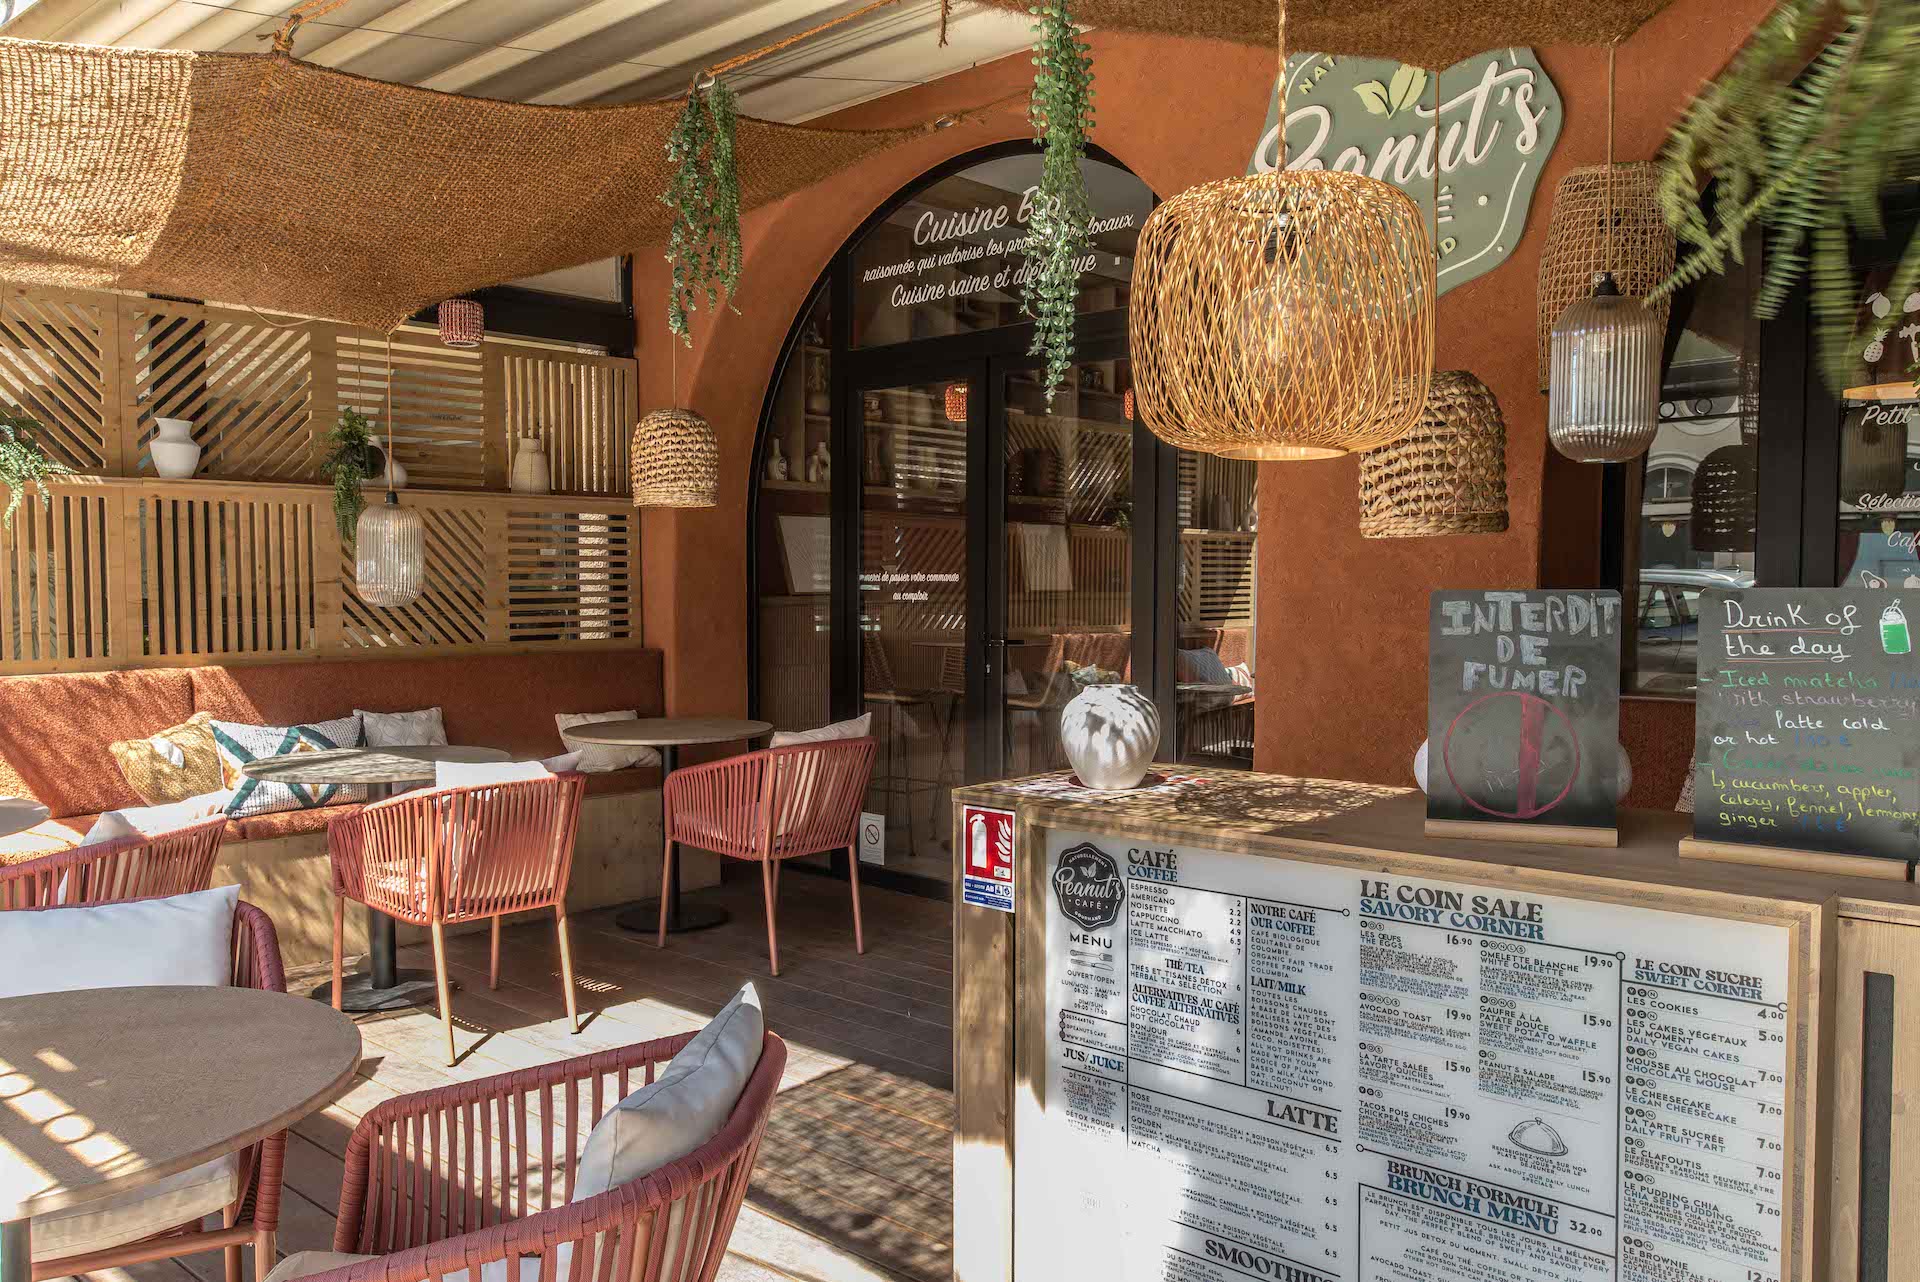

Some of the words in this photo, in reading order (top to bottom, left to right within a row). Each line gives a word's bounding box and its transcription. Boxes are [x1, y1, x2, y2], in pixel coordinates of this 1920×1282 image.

[914, 204, 1010, 246] Cuisine
[1016, 186, 1061, 222] Bo
[863, 260, 915, 282] raisonnée
[917, 254, 936, 276] qui
[938, 244, 984, 267] valorise
[986, 238, 1004, 256] les
[891, 284, 945, 308] Cuisine
[948, 273, 990, 297] saine
[994, 264, 1010, 289] et
[882, 571, 889, 582] de
[911, 571, 926, 582] votre
[927, 573, 959, 582] commande
[893, 592, 901, 600] au
[902, 590, 928, 603] comptoir
[1724, 599, 1810, 628] Drink
[1825, 605, 1862, 635] of
[1497, 634, 1548, 665] DE
[1726, 634, 1775, 657] the
[1790, 636, 1851, 663] day
[1463, 661, 1587, 698] FUMER
[1719, 670, 1771, 688] Iced
[1784, 672, 1880, 689] matcha
[1843, 717, 1890, 730] cold
[1714, 735, 1737, 745] or
[1746, 731, 1779, 745] hot
[1720, 812, 1778, 828] ginger
[1128, 848, 1177, 870] CAFÉ
[1056, 866, 1122, 900] Peanut's
[1128, 865, 1177, 882] COFFEE
[1131, 883, 1168, 894] ESPRESSO
[1075, 899, 1101, 909] CAFÉ
[1131, 893, 1175, 905] AMERICANO
[1131, 902, 1168, 913] NOISETTE
[1361, 880, 1389, 900] LE
[1397, 885, 1463, 911] COIN
[1472, 896, 1543, 923] SALE
[1131, 911, 1179, 925] CAPPUCCINO
[1229, 918, 1241, 926] 2.2
[1250, 903, 1286, 918] NOTRE
[1289, 909, 1316, 923] CAFÉ
[1361, 899, 1444, 924] SAVORY
[1450, 911, 1544, 940] CORNER
[1131, 920, 1154, 929] LATTE
[1157, 925, 1203, 938] MACCHIATO
[1250, 916, 1272, 929] OUR
[1276, 920, 1315, 936] COFFEE
[1361, 930, 1375, 938] LES
[1070, 932, 1112, 948] MENU
[1145, 931, 1168, 941] LATTE
[1273, 934, 1320, 946] BIOLOGIQUE
[1380, 940, 1402, 949] EGGS
[1447, 934, 1472, 946] 16.90
[1165, 958, 1204, 975] THÉ/TEA
[1480, 950, 1530, 964] OMELETTE
[1534, 959, 1579, 972] BLANCHE
[1584, 955, 1612, 968] 19.90
[1131, 963, 1149, 972] THÉS
[1165, 970, 1197, 982] TISANES
[1201, 977, 1227, 989] DÉTOX
[1131, 971, 1157, 982] HERBAL
[1161, 977, 1175, 985] TEA
[1179, 981, 1222, 995] SELECTION
[1636, 958, 1654, 971] LE
[1659, 962, 1701, 978] COIN
[1706, 970, 1763, 989] SUCRE
[1250, 976, 1306, 996] LAIT/MILK
[1635, 970, 1689, 988] SWEET
[1694, 979, 1763, 1000] CORNER
[1132, 983, 1198, 1005] ALTERNATIVES
[1201, 998, 1213, 1008] AU
[1216, 1001, 1239, 1015] CAFÉ
[1627, 997, 1646, 1005] LES
[1650, 1001, 1699, 1016] COOKIES
[1131, 1005, 1171, 1018] CHOCOLAT
[1174, 1015, 1200, 1026] CHAUD
[1132, 993, 1165, 1008] COFFEE
[1168, 1000, 1239, 1025] ALTERNATIVES
[1359, 1003, 1400, 1016] AVOCADO
[1403, 1011, 1432, 1023] TOAST
[1446, 1009, 1472, 1021] 19.90
[1758, 1009, 1784, 1020] 4.00
[1131, 1022, 1167, 1036] BONJOUR
[1149, 1016, 1195, 1032] CHOCOLATE
[1627, 1019, 1645, 1028] LES
[1650, 1022, 1684, 1036] CAKES
[1689, 1029, 1747, 1048] VÉGÉTAUX
[1090, 1055, 1125, 1072] JUICE
[1359, 1052, 1370, 1060] LA
[1373, 1055, 1398, 1066] TARTE
[1403, 1060, 1428, 1073] SALÉE
[1359, 1059, 1392, 1072] SAVORY
[1396, 1067, 1434, 1081] QUICHES
[1445, 1060, 1471, 1073] 15.90
[1479, 1059, 1519, 1073] PEANUT'S
[1523, 1069, 1555, 1081] SALADE
[1069, 1072, 1091, 1082] DÉTOX
[1094, 1079, 1111, 1088] VERT
[1131, 1092, 1150, 1102] ROSE
[1065, 1109, 1088, 1121] DÉTOX
[1091, 1117, 1115, 1129] ROUGE
[1131, 1115, 1161, 1129] GOLDEN
[1267, 1100, 1338, 1134] LATTE
[1359, 1100, 1386, 1112] TACOS
[1389, 1107, 1409, 1118] POIS
[1412, 1114, 1449, 1128] CHICHES
[1131, 1140, 1161, 1153] MATCHA
[1625, 1146, 1637, 1154] LE
[1641, 1150, 1702, 1170] CLAFOUTIS
[1387, 1160, 1461, 1192] BRUNCH
[1467, 1183, 1558, 1220] FORMULE
[1387, 1174, 1481, 1214] BRUNCH
[1488, 1201, 1558, 1235] MENU
[1570, 1220, 1602, 1237] 32.00
[1624, 1246, 1634, 1254] LE
[1639, 1250, 1688, 1270] BROWNIE
